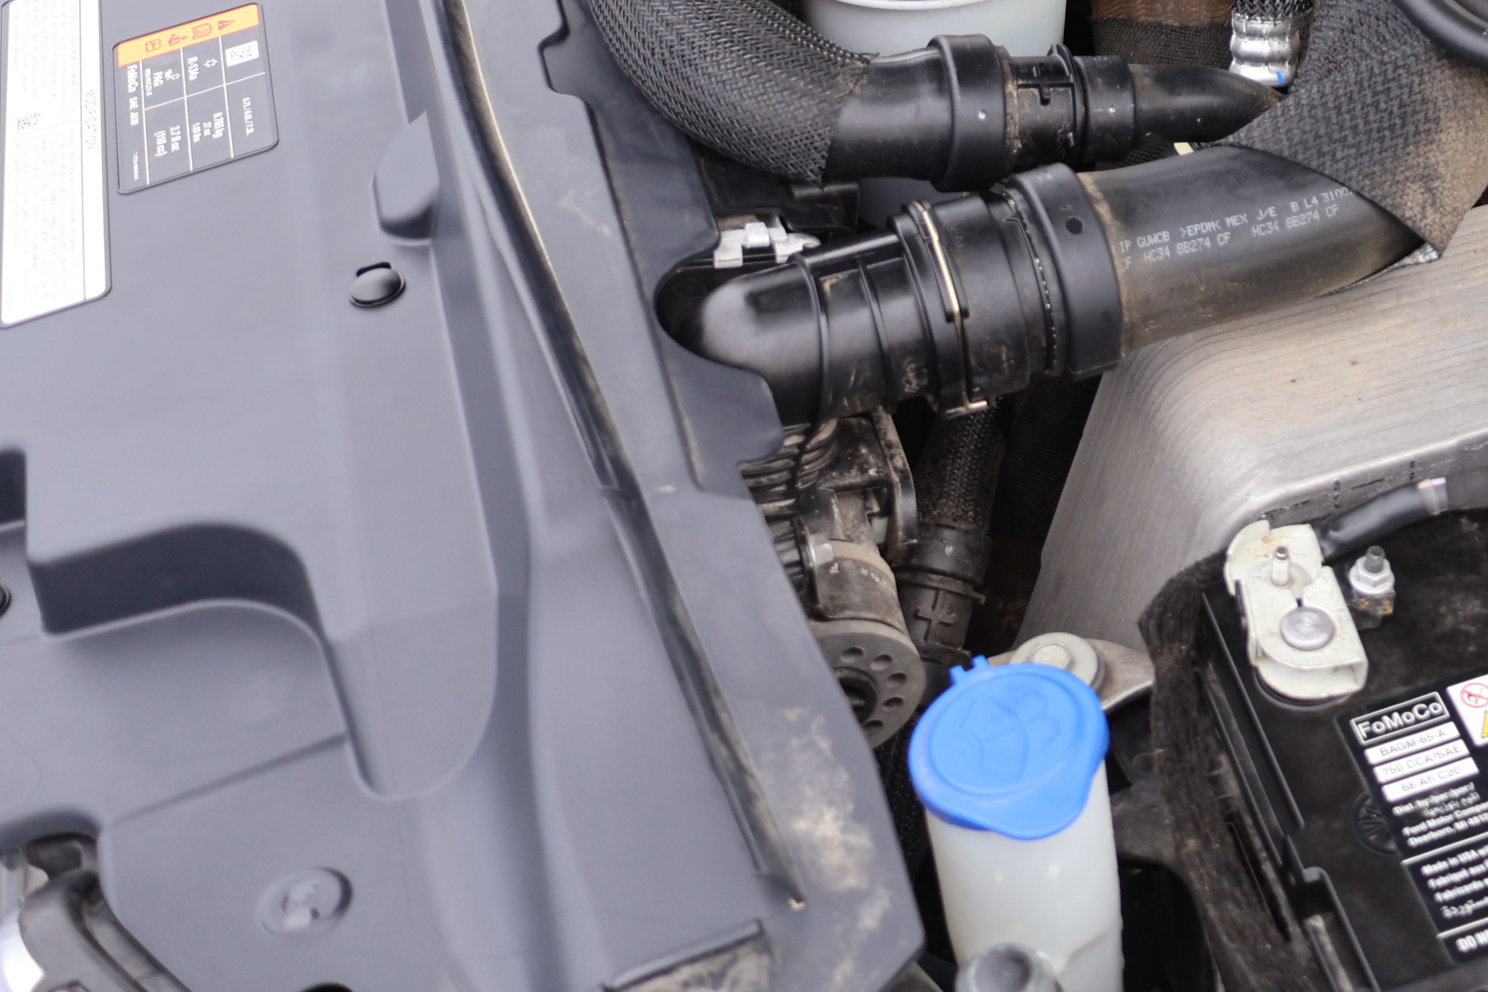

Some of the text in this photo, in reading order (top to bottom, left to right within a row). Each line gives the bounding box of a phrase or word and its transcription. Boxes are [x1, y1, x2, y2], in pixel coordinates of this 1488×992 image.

[1226, 213, 1249, 228] MEX
[1290, 200, 1300, 212] B
[1356, 698, 1444, 738] FoMoCo
[1401, 820, 1428, 836] Ford
[1424, 812, 1454, 829] Motor
[1406, 825, 1455, 846] Dearborn,
[1452, 819, 1469, 831] MI
[1420, 859, 1449, 876] Made
[1446, 855, 1460, 867] in
[1456, 848, 1479, 863] USA
[1455, 934, 1478, 951] DO
